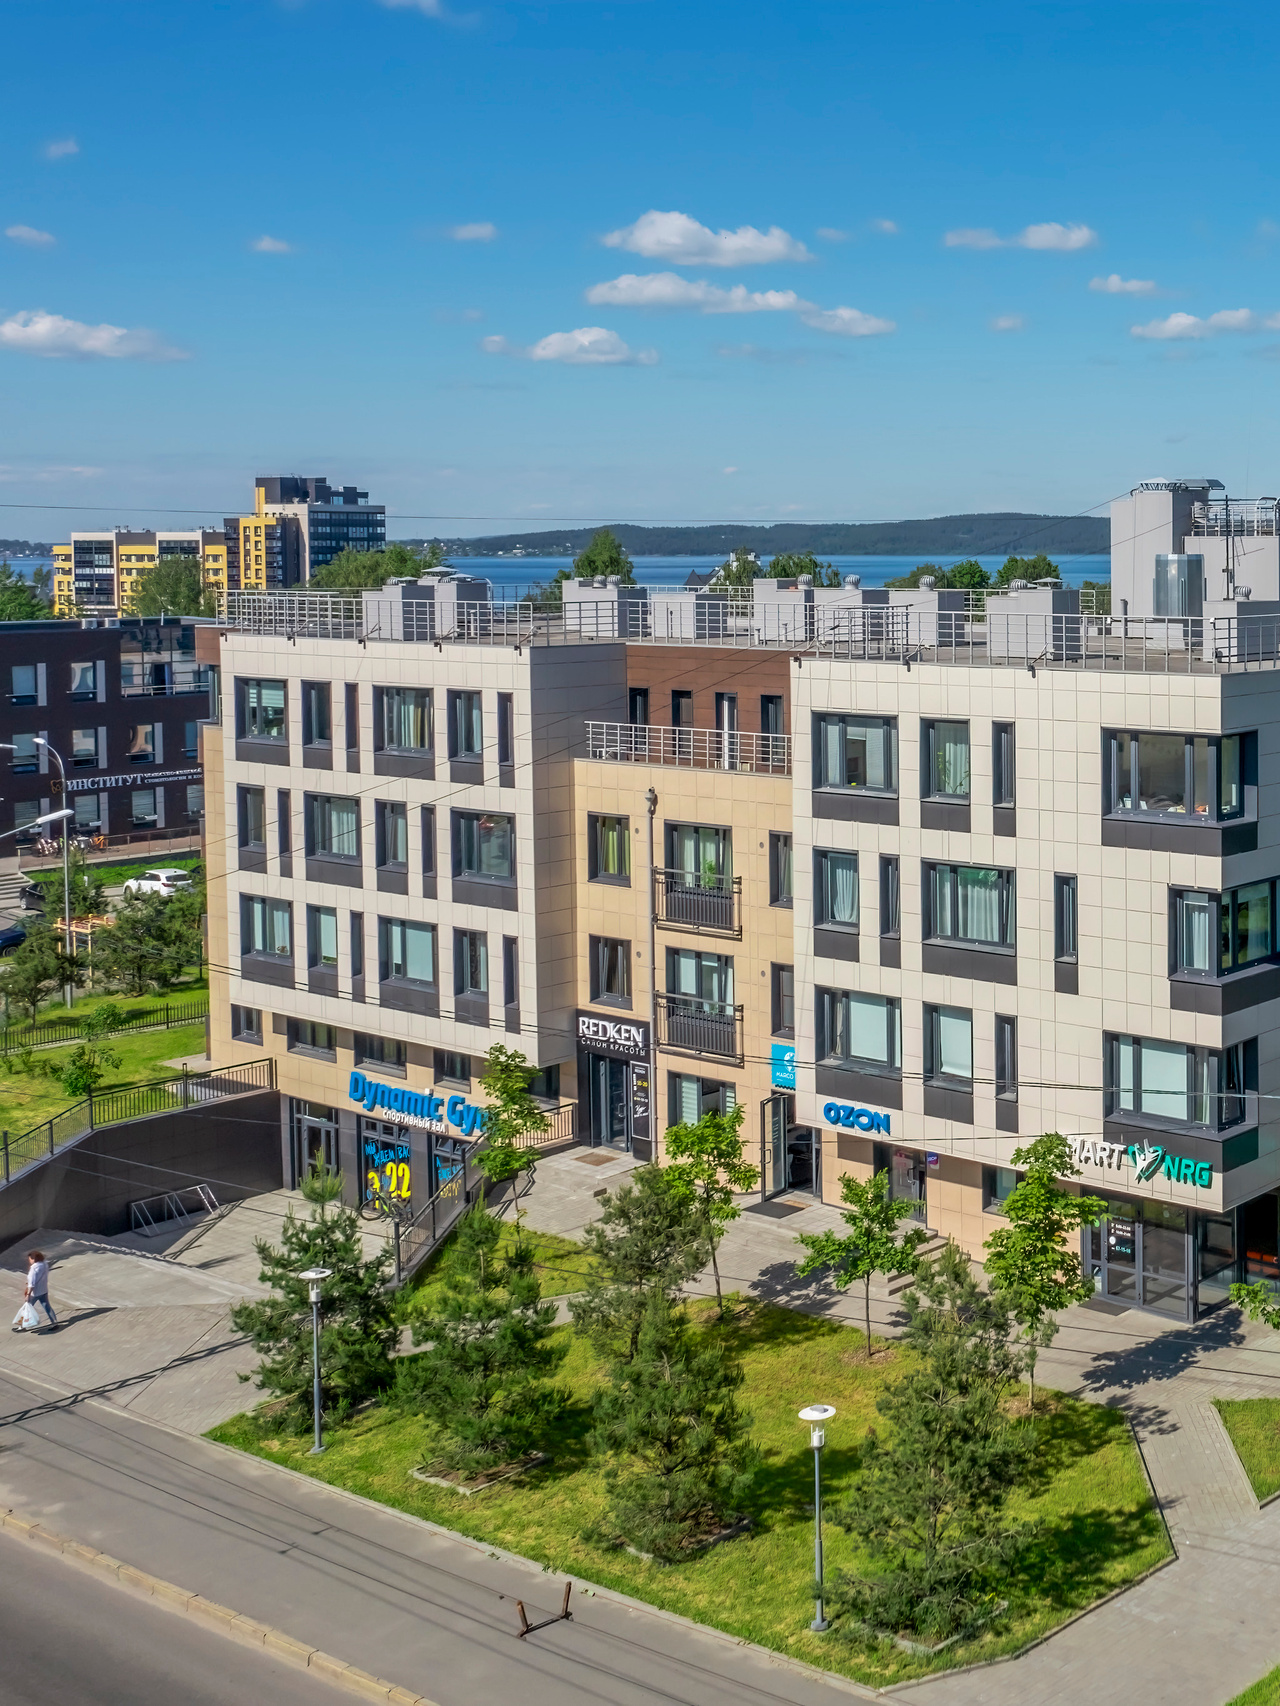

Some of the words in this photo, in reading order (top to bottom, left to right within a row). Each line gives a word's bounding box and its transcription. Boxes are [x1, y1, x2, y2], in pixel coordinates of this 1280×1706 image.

[67, 773, 144, 791] ИНСТИТУТ
[579, 1017, 644, 1047] REDKEN
[581, 1038, 607, 1049] САЛОН
[610, 1044, 646, 1056] КРАСОТЫ
[776, 1071, 794, 1080] MARCO
[349, 1071, 444, 1122] Dynamic
[383, 1109, 430, 1130] спортивный
[432, 1121, 445, 1133] зал
[823, 1102, 891, 1136] OZON
[1066, 1136, 1127, 1171] MART
[1164, 1154, 1213, 1189] NRG
[386, 1161, 411, 1198] 22
